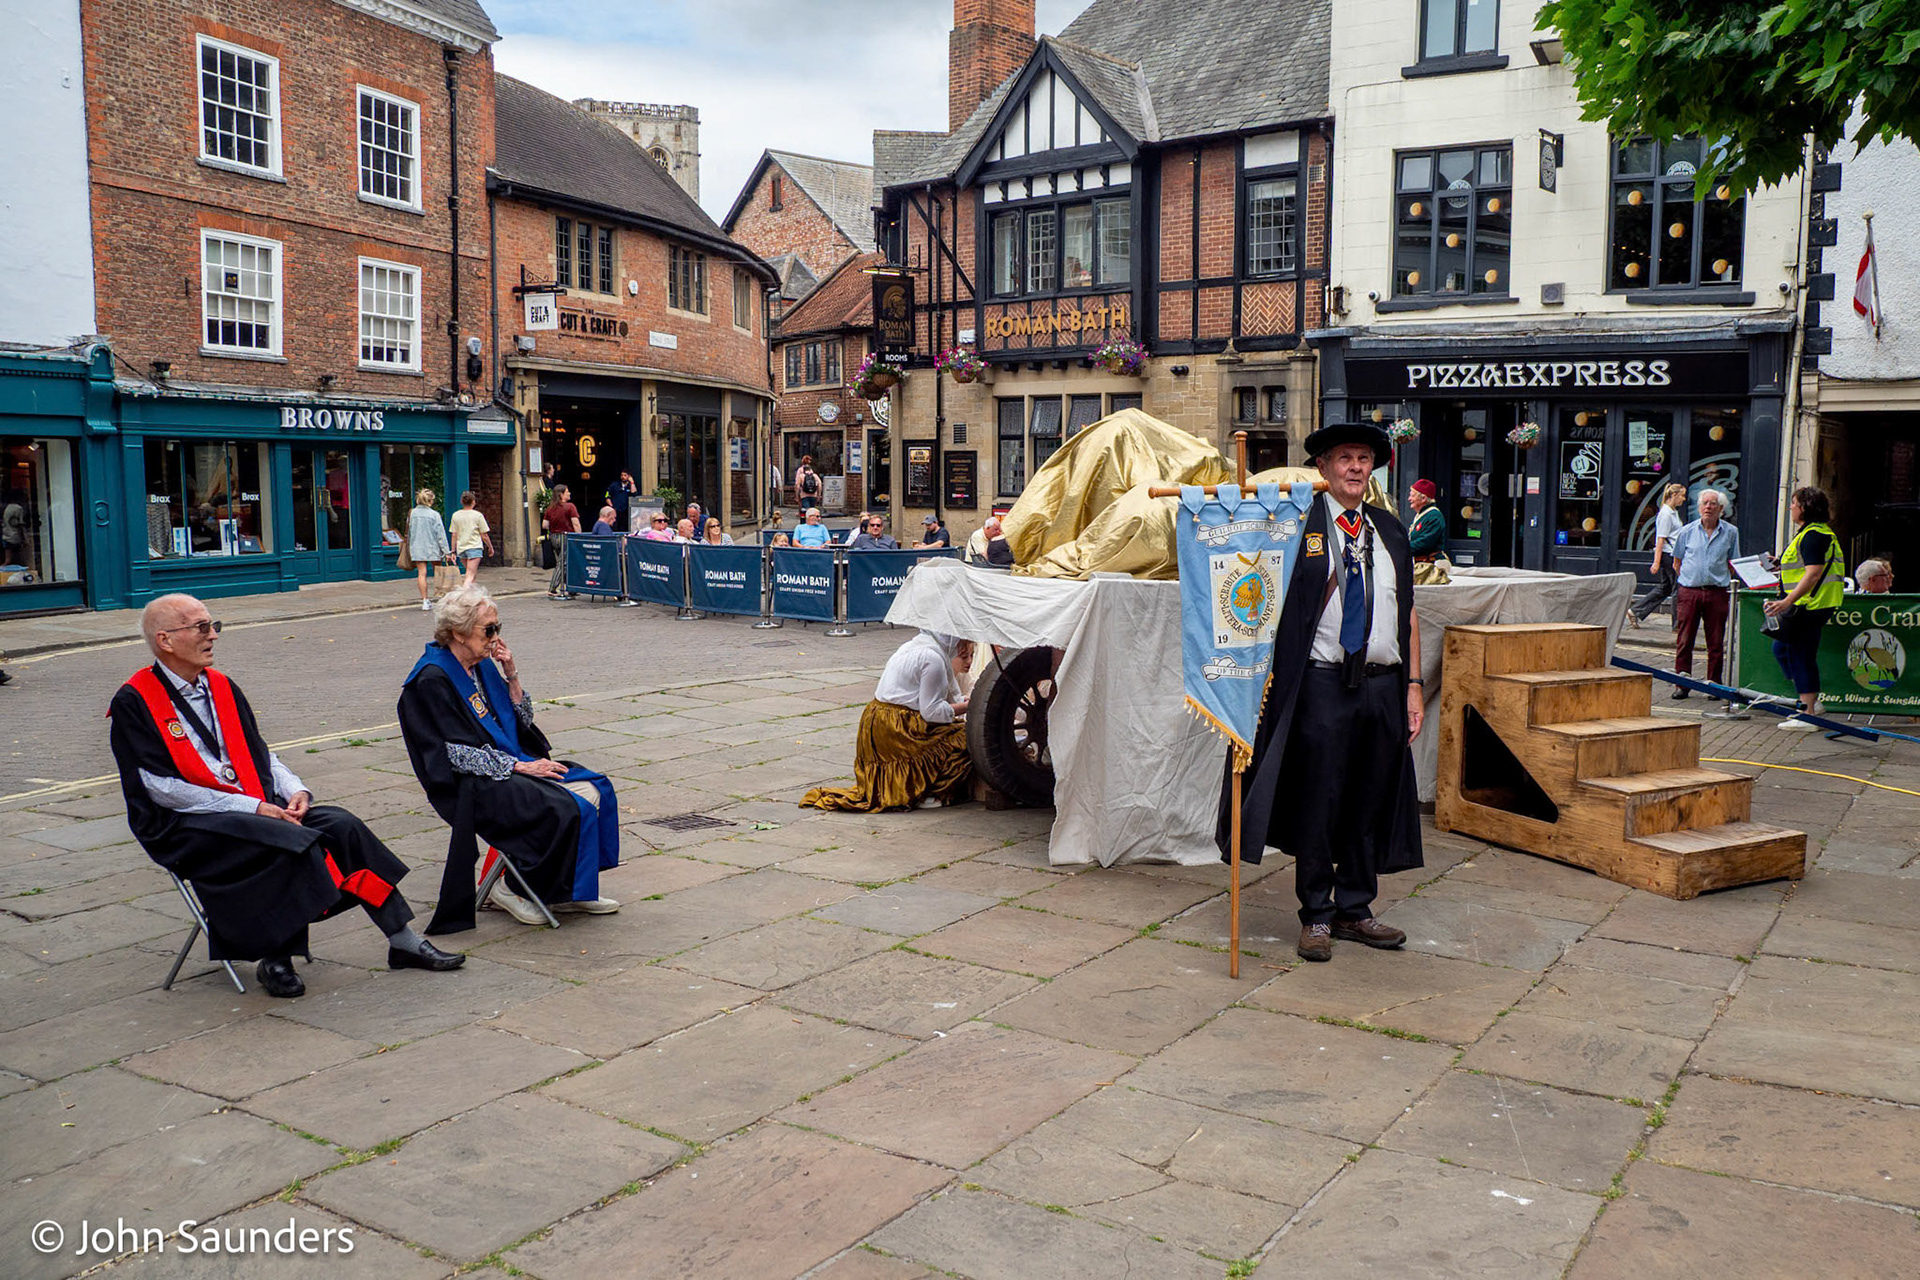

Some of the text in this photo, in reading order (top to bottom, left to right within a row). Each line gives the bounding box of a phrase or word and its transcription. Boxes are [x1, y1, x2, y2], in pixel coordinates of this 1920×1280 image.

[531, 305, 549, 315] CUT &
[531, 315, 549, 323] CRAFT
[560, 312, 618, 336] CUT & CRAFT
[985, 306, 1126, 339] ROMAN BATH
[879, 319, 911, 332] ROMAN
[885, 330, 905, 338] BATH
[885, 354, 908, 362] ROOMS
[1406, 360, 1672, 388] PIZZAEXPRESS
[280, 407, 384, 431] BROWNS
[150, 494, 171, 504] Brax
[241, 492, 260, 501] Brax
[388, 490, 404, 499] Brax
[1208, 525, 1232, 537] GUILD
[1214, 560, 1224, 570] 14
[1271, 556, 1281, 565] 87
[704, 569, 746, 581] ROMAN BATH
[776, 573, 830, 587] ROMAN BATH
[871, 576, 906, 587] ROMAN
[1219, 568, 1242, 605] SCRIBITE
[1217, 634, 1228, 644] 19
[1845, 693, 1870, 703] Wine
[1872, 695, 1880, 703] &
